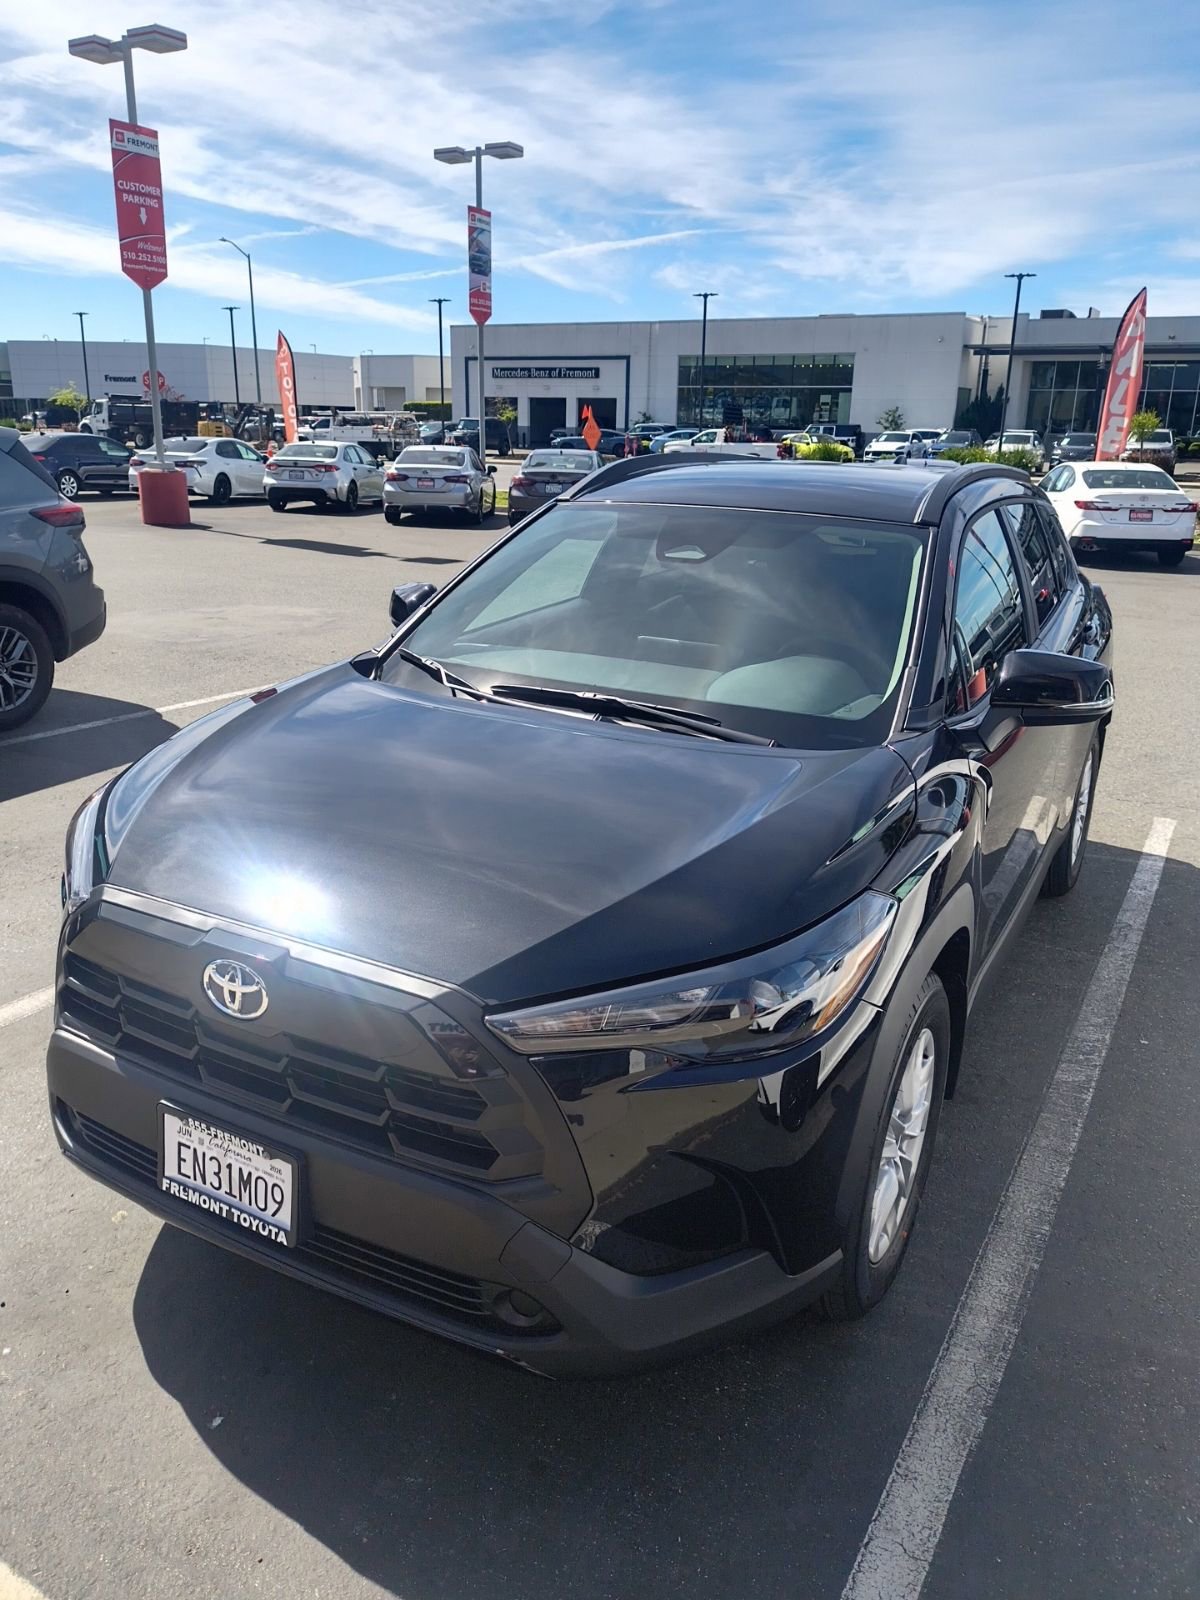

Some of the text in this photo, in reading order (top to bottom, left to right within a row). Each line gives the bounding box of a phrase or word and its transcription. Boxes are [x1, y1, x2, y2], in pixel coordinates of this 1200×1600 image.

[127, 137, 159, 152] FREMONT
[117, 180, 161, 197] CUSTOMER
[122, 193, 159, 208] PARKING
[104, 374, 137, 383] Fremont
[493, 368, 596, 378] Mercedes-Benz of Fremont
[177, 1125, 193, 1138] JUN
[188, 1118, 265, 1157] 855-FREMONT
[208, 1137, 252, 1163] California
[177, 1141, 285, 1218] EN31M09
[162, 1177, 288, 1246] FREMONT TOYOTA
